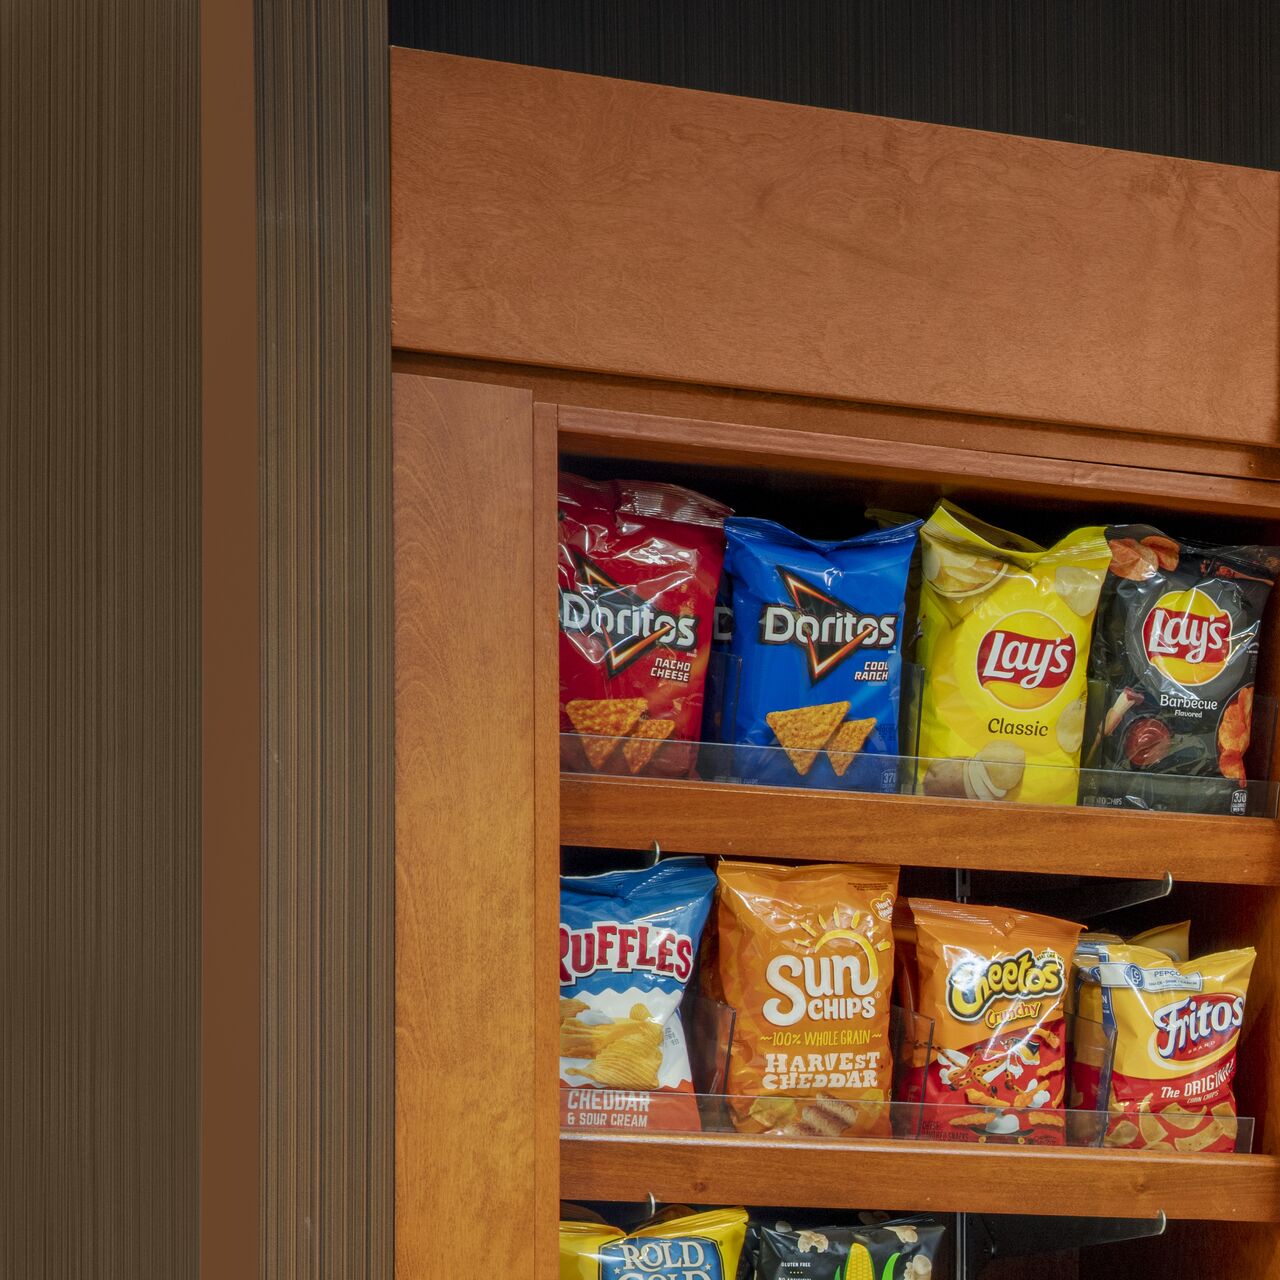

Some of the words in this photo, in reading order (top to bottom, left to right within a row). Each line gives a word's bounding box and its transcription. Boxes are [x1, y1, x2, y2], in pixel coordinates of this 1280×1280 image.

[562, 592, 696, 648] Doritos
[764, 606, 896, 645] Doritos
[1149, 609, 1227, 663] Lay's
[655, 658, 691, 671] NACHO
[983, 631, 1072, 689] Lay's
[651, 668, 689, 682] CHEESE
[854, 671, 888, 681] RANCH
[1160, 694, 1218, 711] Barbecue
[1174, 710, 1202, 718] Flavored
[988, 718, 1048, 736] Classic
[949, 949, 1063, 1020] Cheetos
[807, 998, 876, 1020] CHIPS
[985, 1002, 1041, 1027] Crunchy
[1154, 997, 1244, 1059] Fritos
[772, 1031, 801, 1046] 100%
[804, 1031, 839, 1046] WHOLE
[841, 1031, 871, 1045] GRAIN
[764, 1052, 880, 1072] HARVEST
[762, 1070, 878, 1089] CHEDDAR
[568, 1090, 650, 1110] CHEDDAR
[567, 1113, 575, 1125] &
[579, 1113, 607, 1126] SOUR
[610, 1113, 647, 1127] CREAM
[622, 1239, 706, 1269] ROLD
